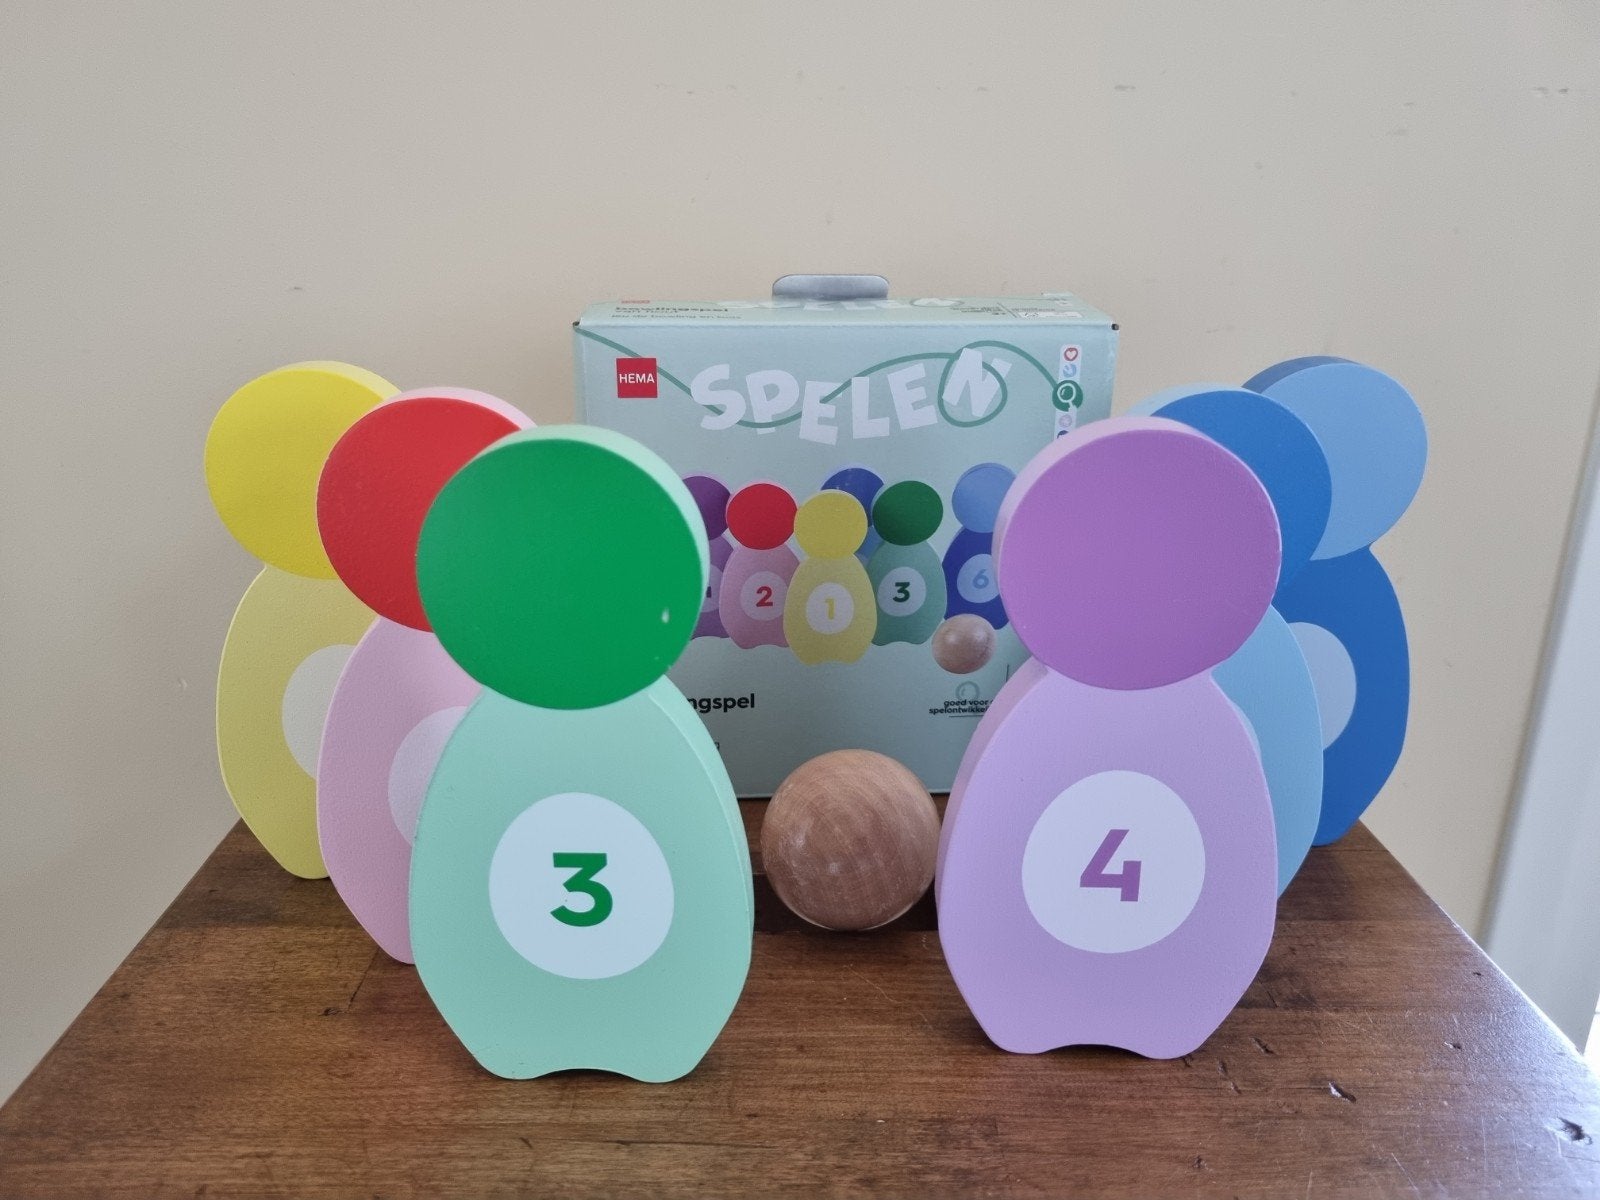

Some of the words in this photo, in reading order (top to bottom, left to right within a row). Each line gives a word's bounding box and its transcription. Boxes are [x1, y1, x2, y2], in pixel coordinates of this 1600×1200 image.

[619, 373, 655, 384] HEMA
[690, 347, 1012, 446] SPELEN
[972, 568, 990, 590] 6
[755, 585, 774, 608] 2
[892, 581, 911, 603] 3
[824, 598, 835, 620] 1
[687, 693, 755, 714] ngspel
[928, 706, 989, 715] spelontwikkel
[944, 699, 967, 707] goed
[1079, 829, 1142, 902] 4
[550, 852, 613, 927] 3
